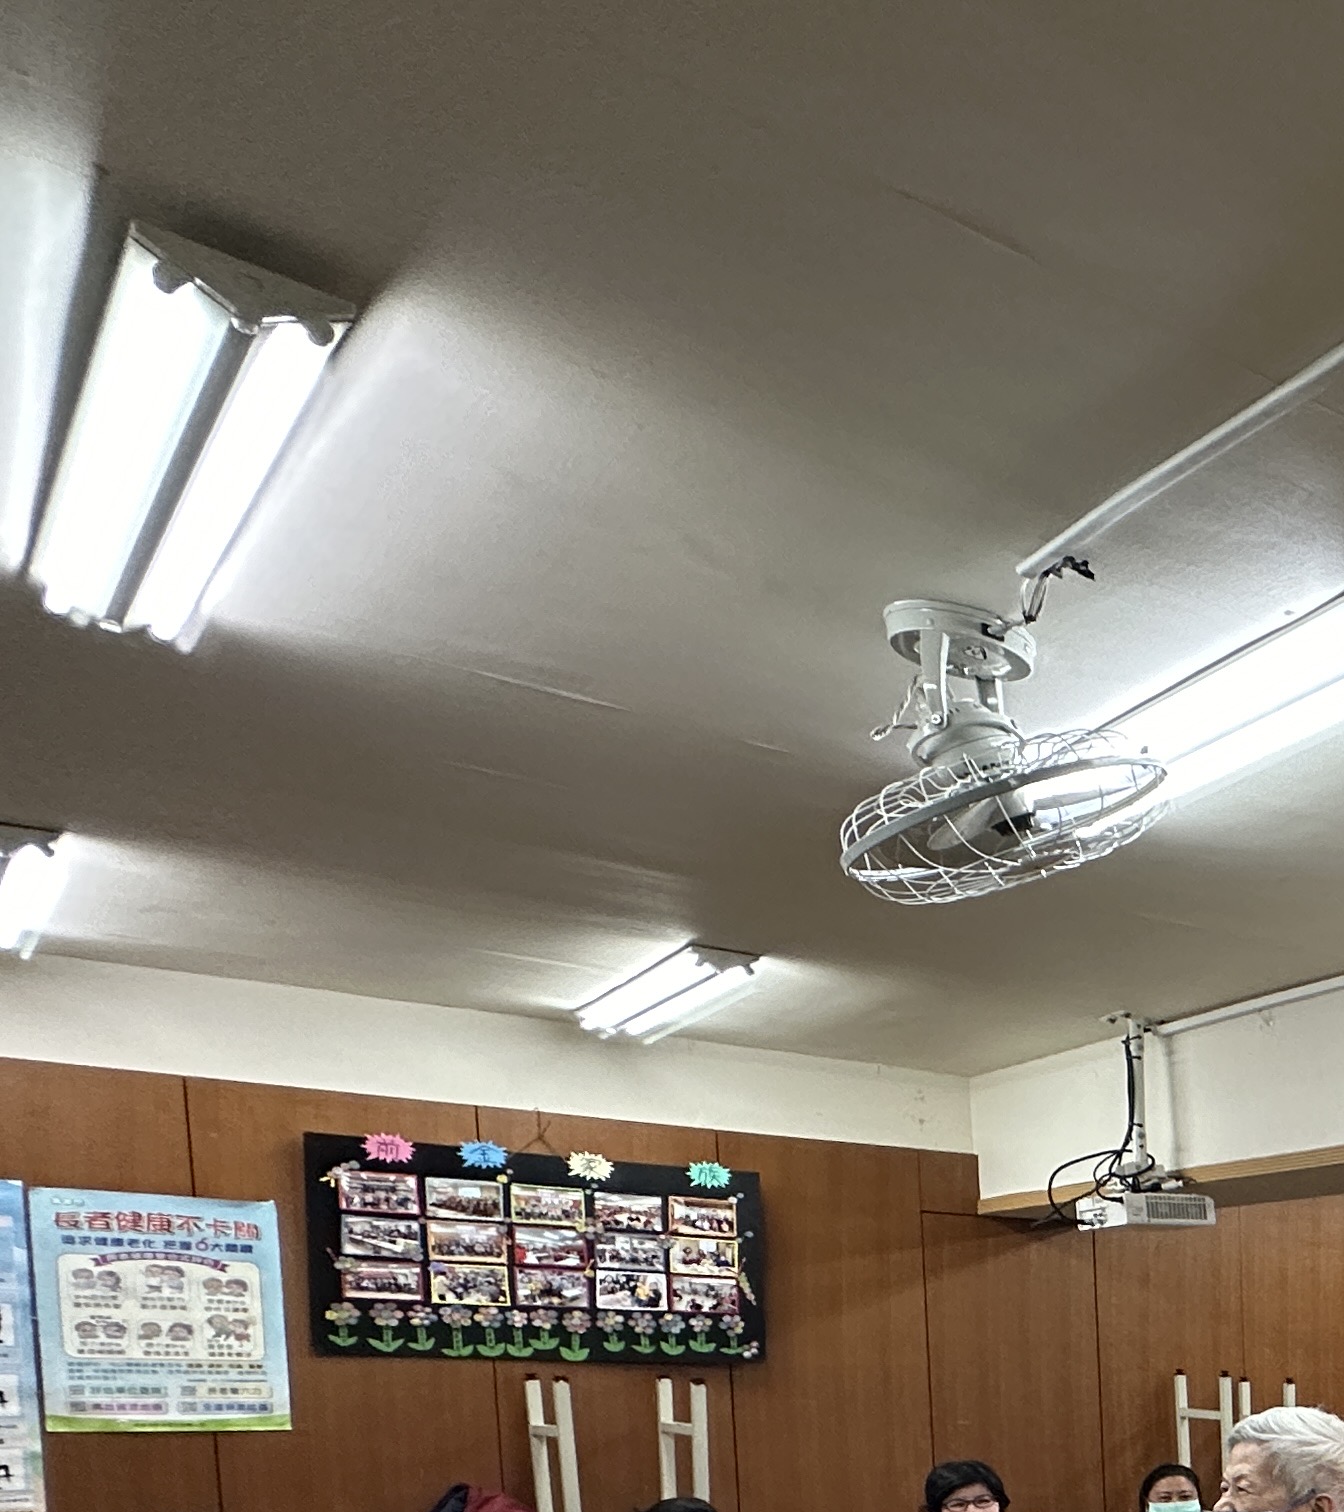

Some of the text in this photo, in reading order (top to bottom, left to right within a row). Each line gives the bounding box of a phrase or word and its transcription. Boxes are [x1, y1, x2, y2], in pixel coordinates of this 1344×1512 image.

[54, 1211, 262, 1241] 長者健康不卡關
